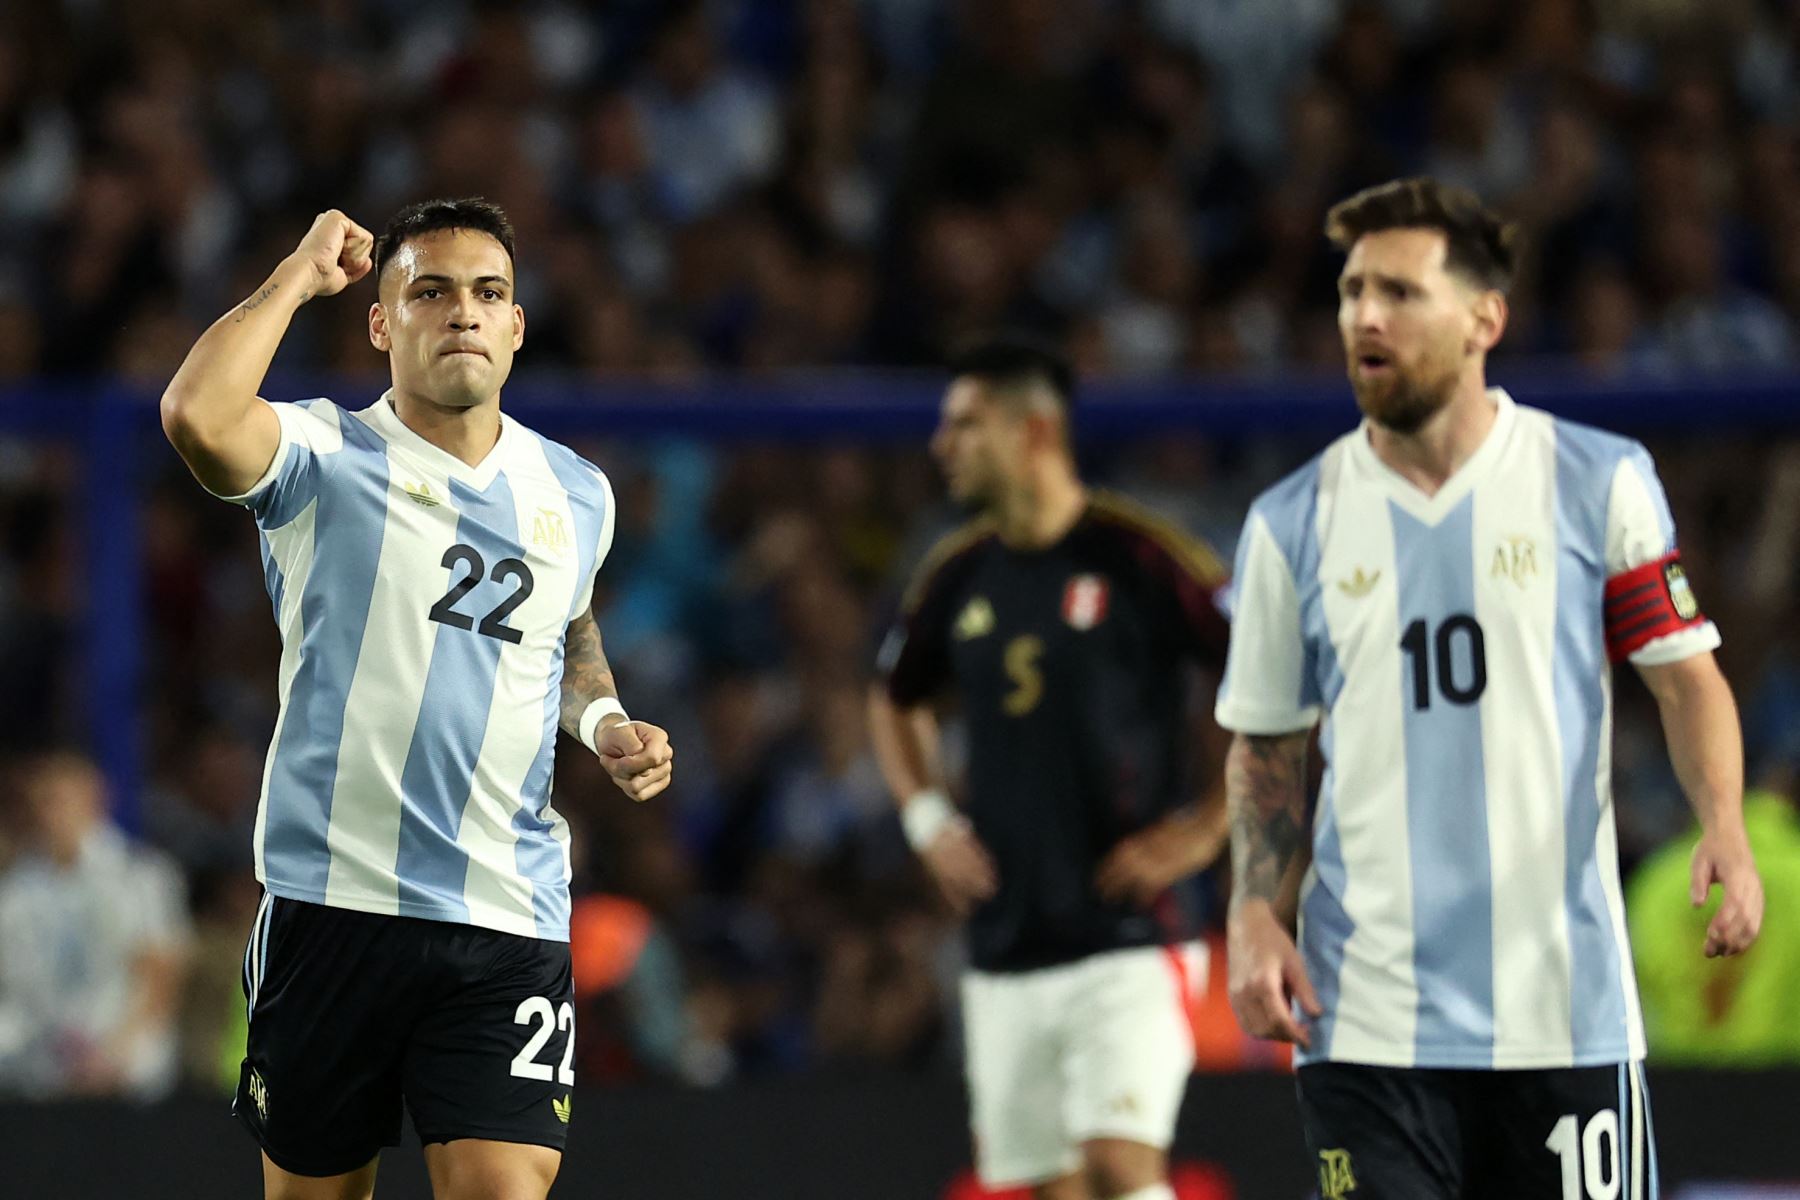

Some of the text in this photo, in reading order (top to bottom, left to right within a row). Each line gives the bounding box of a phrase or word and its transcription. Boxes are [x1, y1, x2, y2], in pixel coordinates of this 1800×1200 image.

[428, 543, 534, 645] 22
[1003, 634, 1044, 717] 5
[1399, 613, 1487, 711] 10
[510, 996, 575, 1086] 22
[1545, 1108, 1621, 1200] 10
